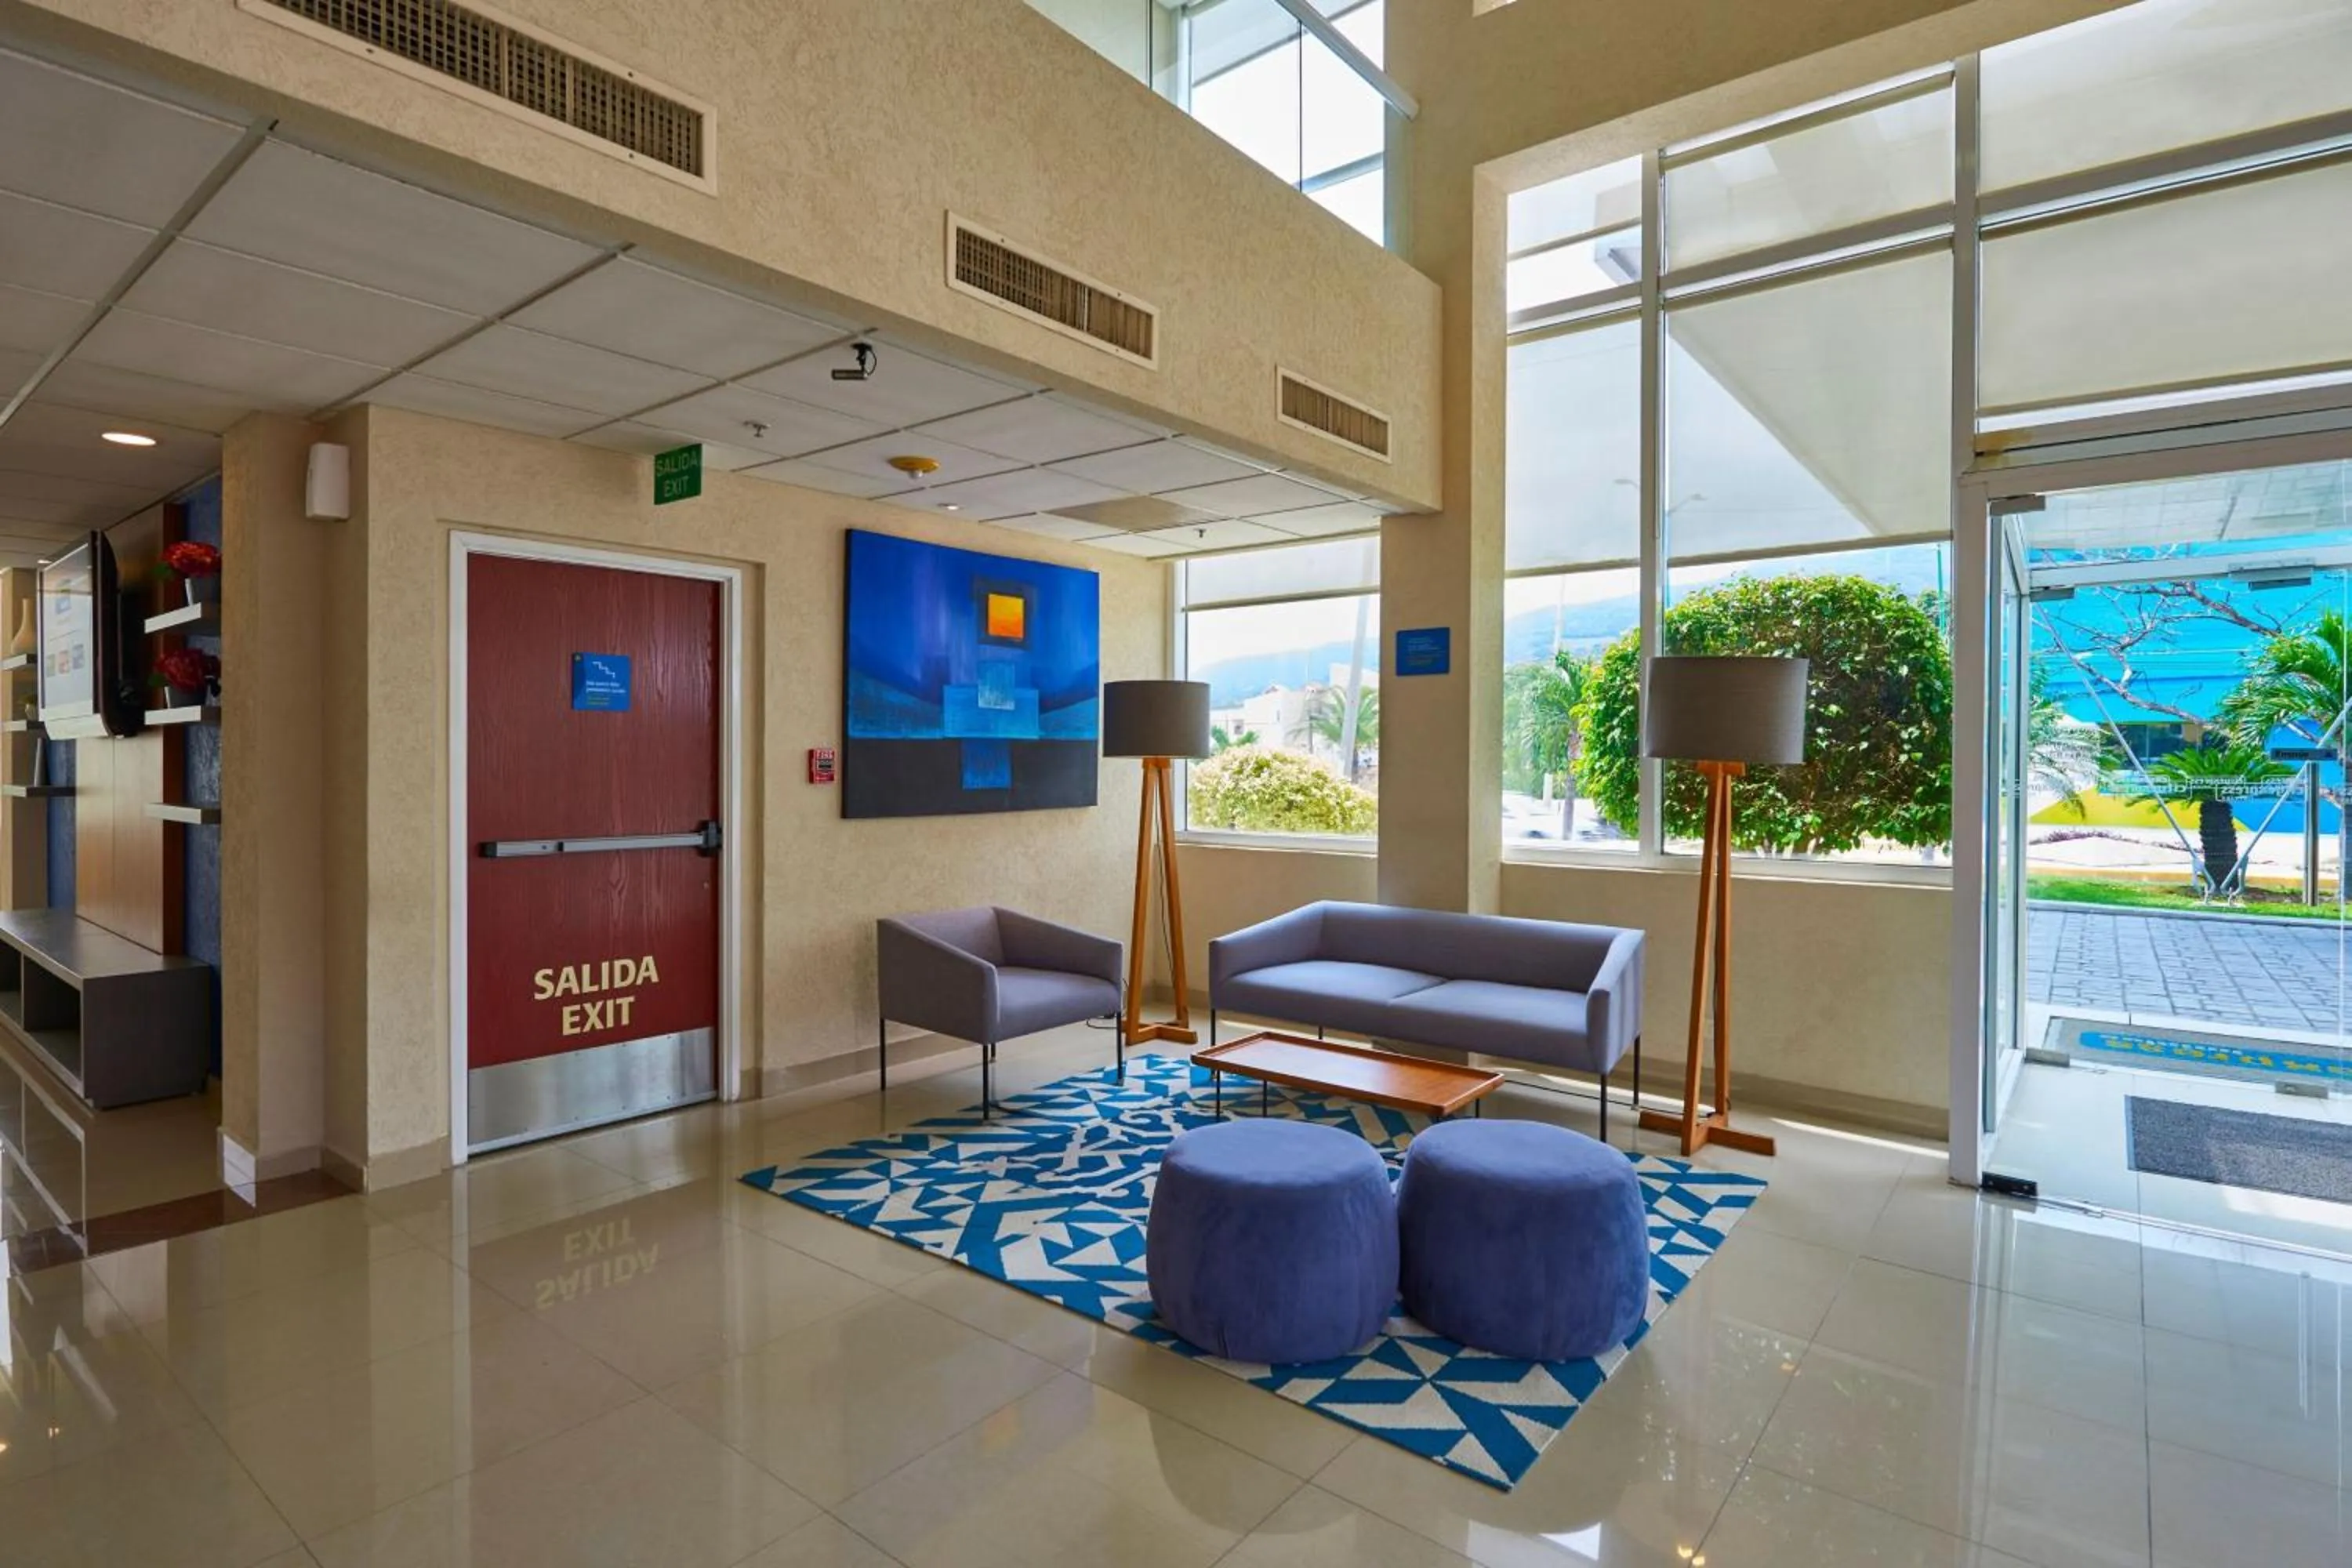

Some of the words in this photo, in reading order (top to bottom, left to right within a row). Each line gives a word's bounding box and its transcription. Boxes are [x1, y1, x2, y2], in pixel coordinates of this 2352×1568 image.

[656, 450, 698, 477] SALIDA
[663, 475, 690, 498] EXIT
[533, 955, 659, 1000] SALIDA
[561, 996, 636, 1036] EXIT
